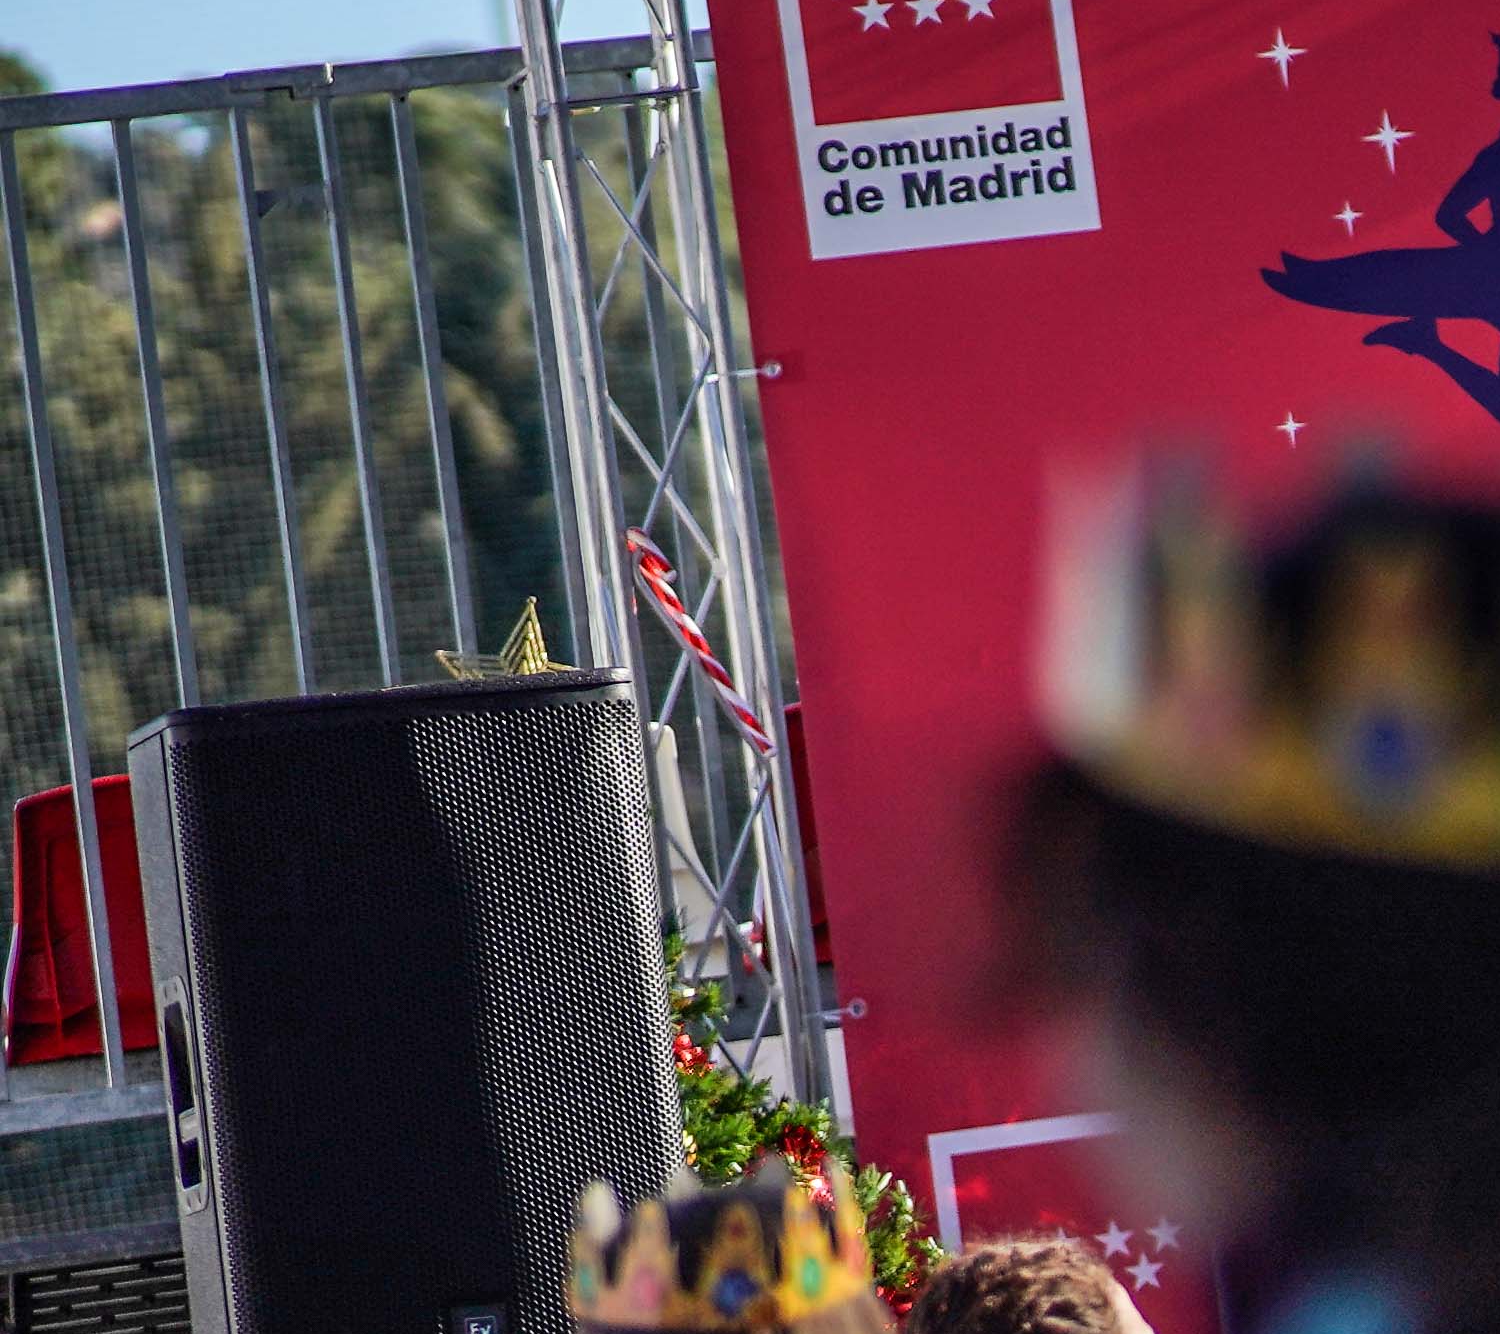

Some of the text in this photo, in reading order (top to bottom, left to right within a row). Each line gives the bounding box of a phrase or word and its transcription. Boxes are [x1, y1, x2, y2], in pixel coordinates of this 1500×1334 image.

[817, 116, 1073, 173] Comunidad
[823, 155, 1077, 216] de Madrid
